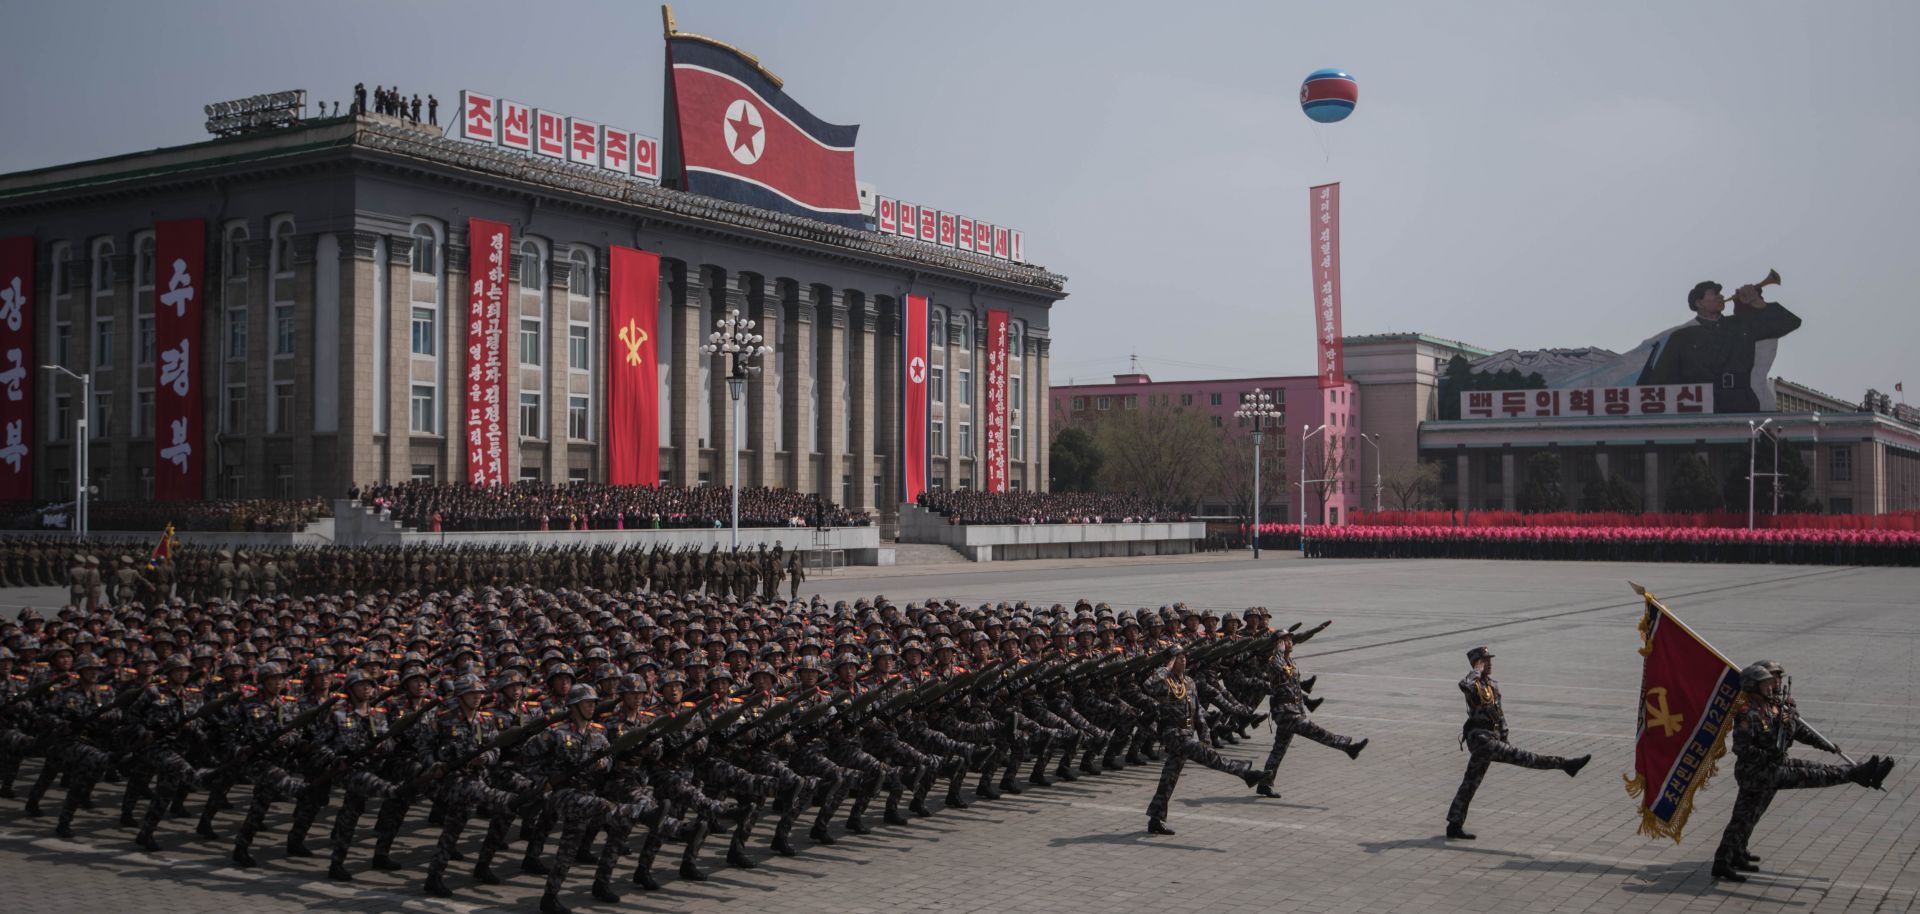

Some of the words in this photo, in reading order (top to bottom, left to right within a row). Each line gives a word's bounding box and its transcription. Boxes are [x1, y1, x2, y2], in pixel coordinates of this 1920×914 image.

[468, 95, 657, 176] 조선민주주의
[1320, 187, 1332, 224] 위대한
[1325, 348, 1337, 385] 만세!
[1664, 741, 1707, 805] 조선인민군
